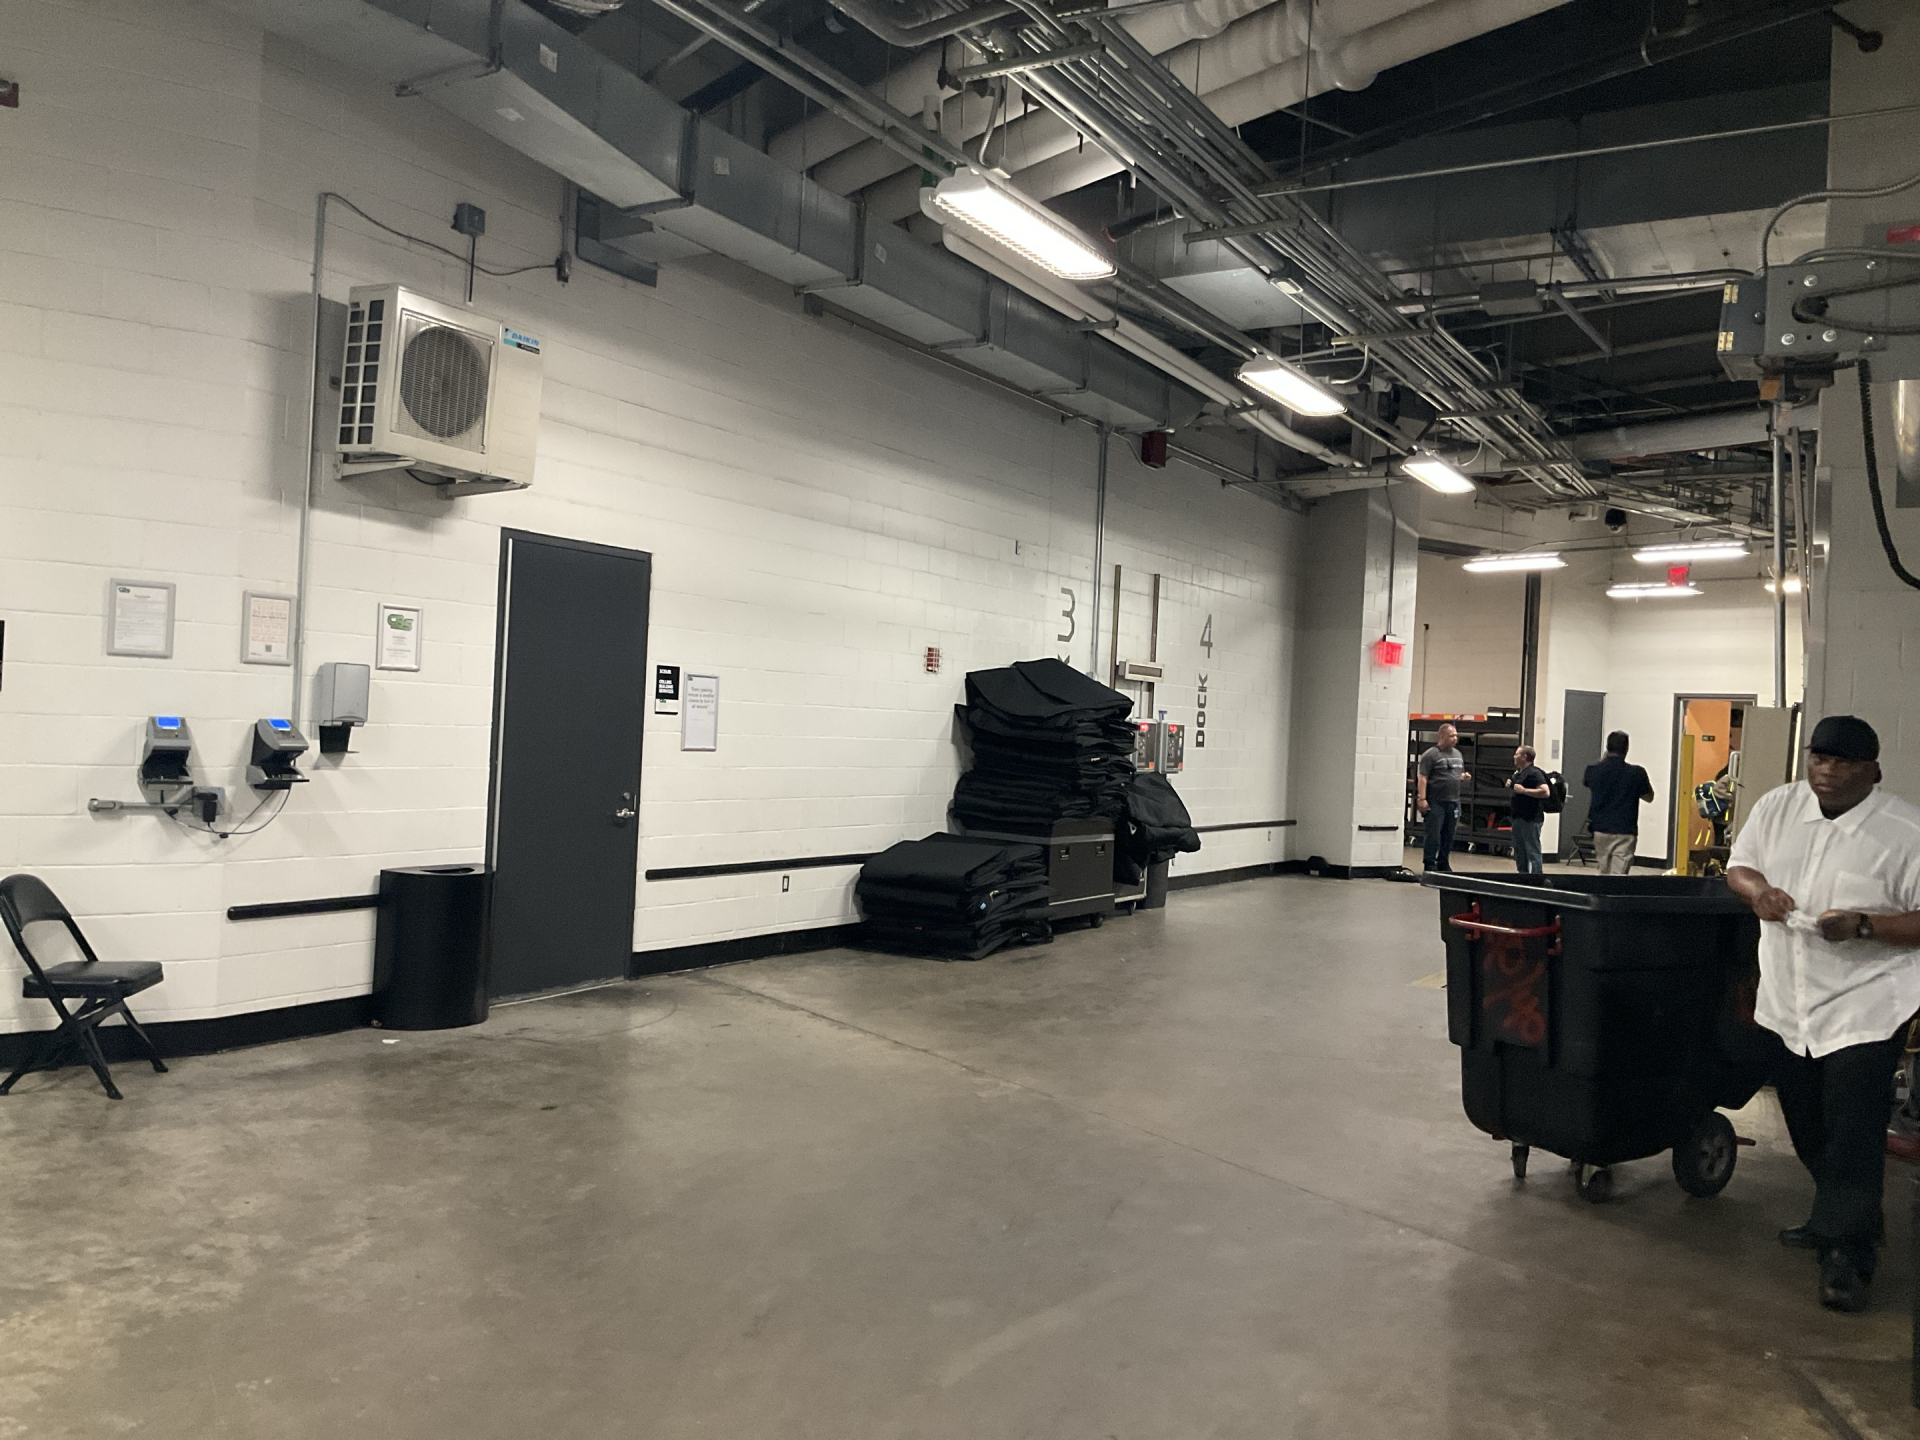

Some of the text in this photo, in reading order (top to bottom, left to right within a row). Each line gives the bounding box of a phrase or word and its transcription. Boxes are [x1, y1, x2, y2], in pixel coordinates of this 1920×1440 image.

[512, 333, 539, 346] DAIKIN
[1057, 587, 1076, 643] 3
[1195, 613, 1213, 748] DOCK 4
